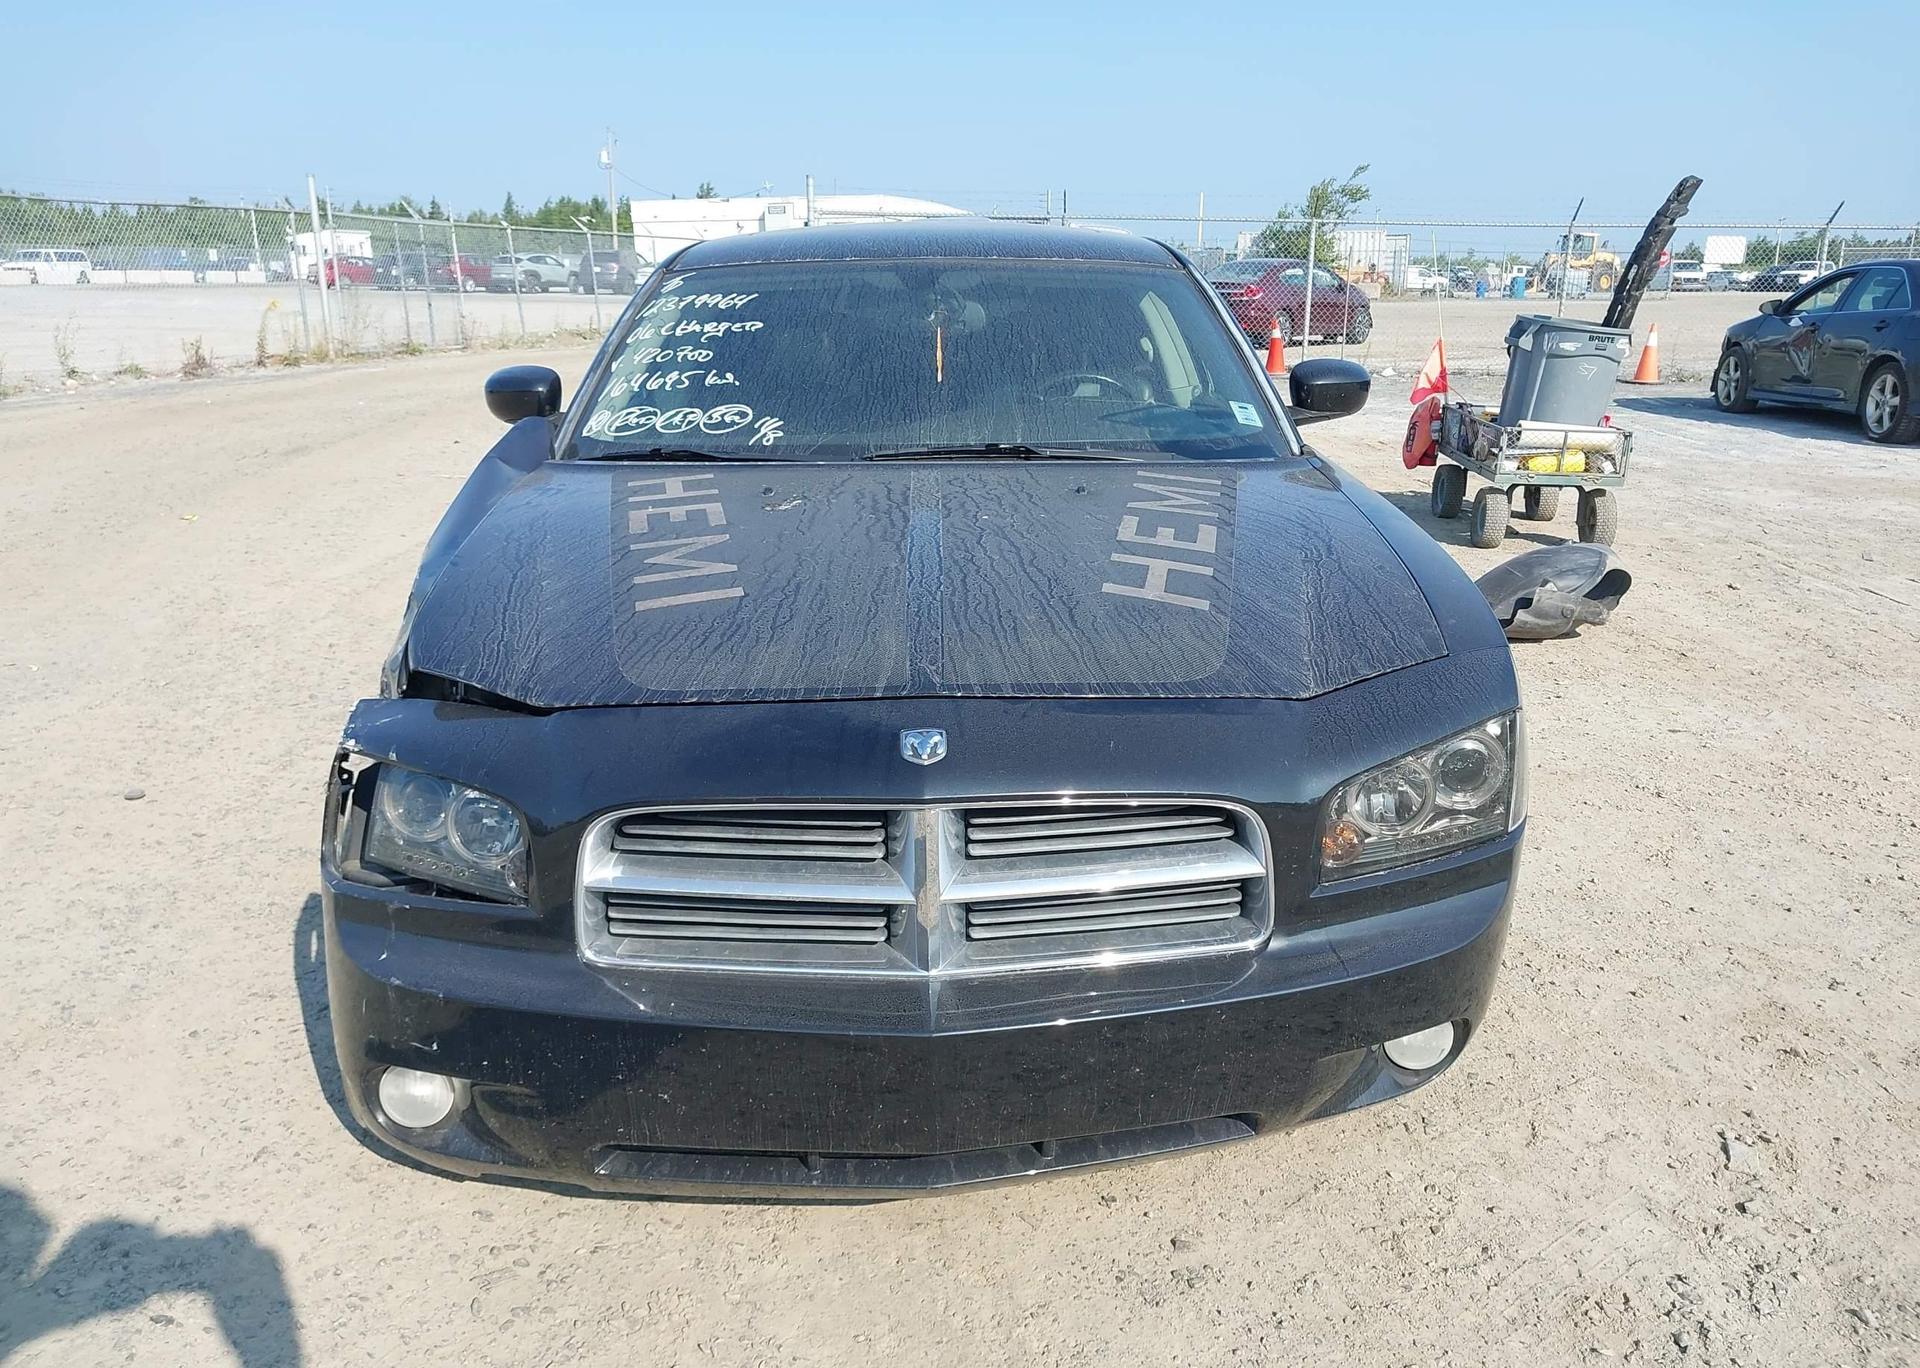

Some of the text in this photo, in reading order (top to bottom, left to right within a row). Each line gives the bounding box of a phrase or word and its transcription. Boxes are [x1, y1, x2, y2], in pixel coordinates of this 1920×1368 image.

[1588, 334, 1616, 344] BRUTE
[627, 473, 745, 612] HEMI
[1101, 470, 1222, 611] HEMI
